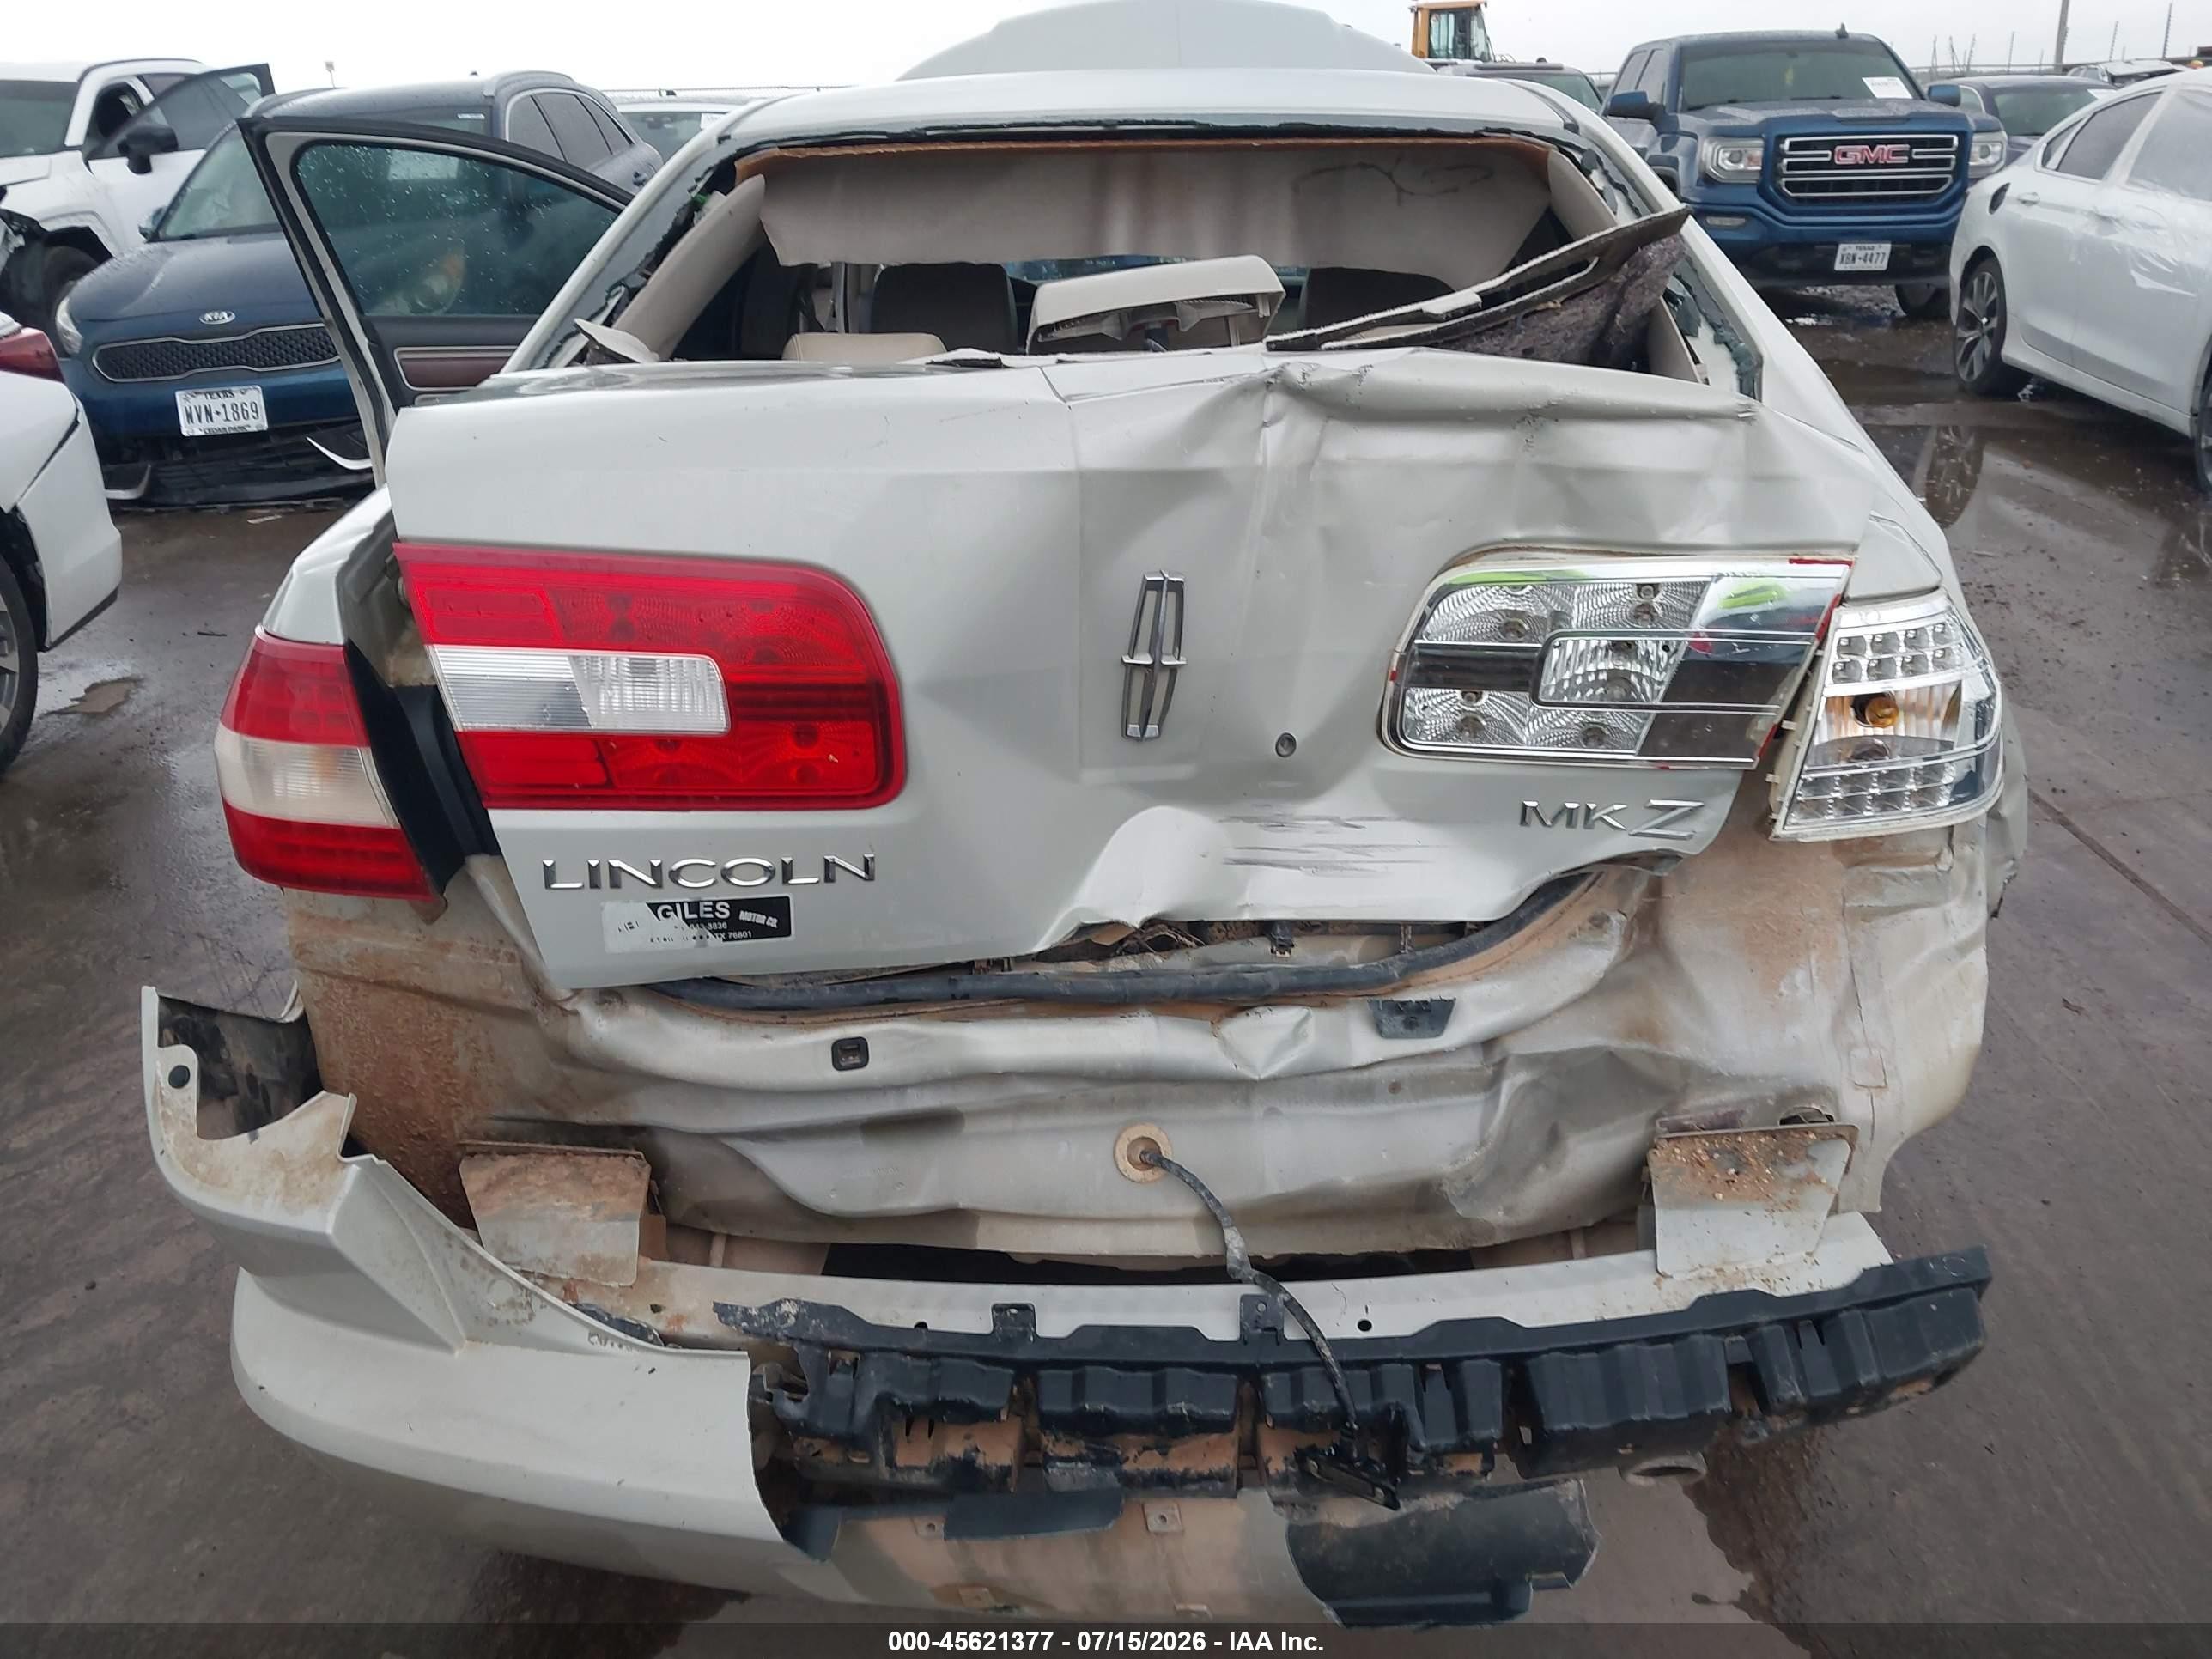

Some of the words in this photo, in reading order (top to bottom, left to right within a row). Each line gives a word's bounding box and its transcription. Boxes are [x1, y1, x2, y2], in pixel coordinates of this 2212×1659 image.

[1834, 144, 1910, 164] GMC
[204, 310, 228, 321] KIA
[204, 390, 235, 400] TEXAS
[543, 854, 875, 890] LINCOLN
[657, 902, 730, 920] GILES
[728, 930, 752, 940] 76801
